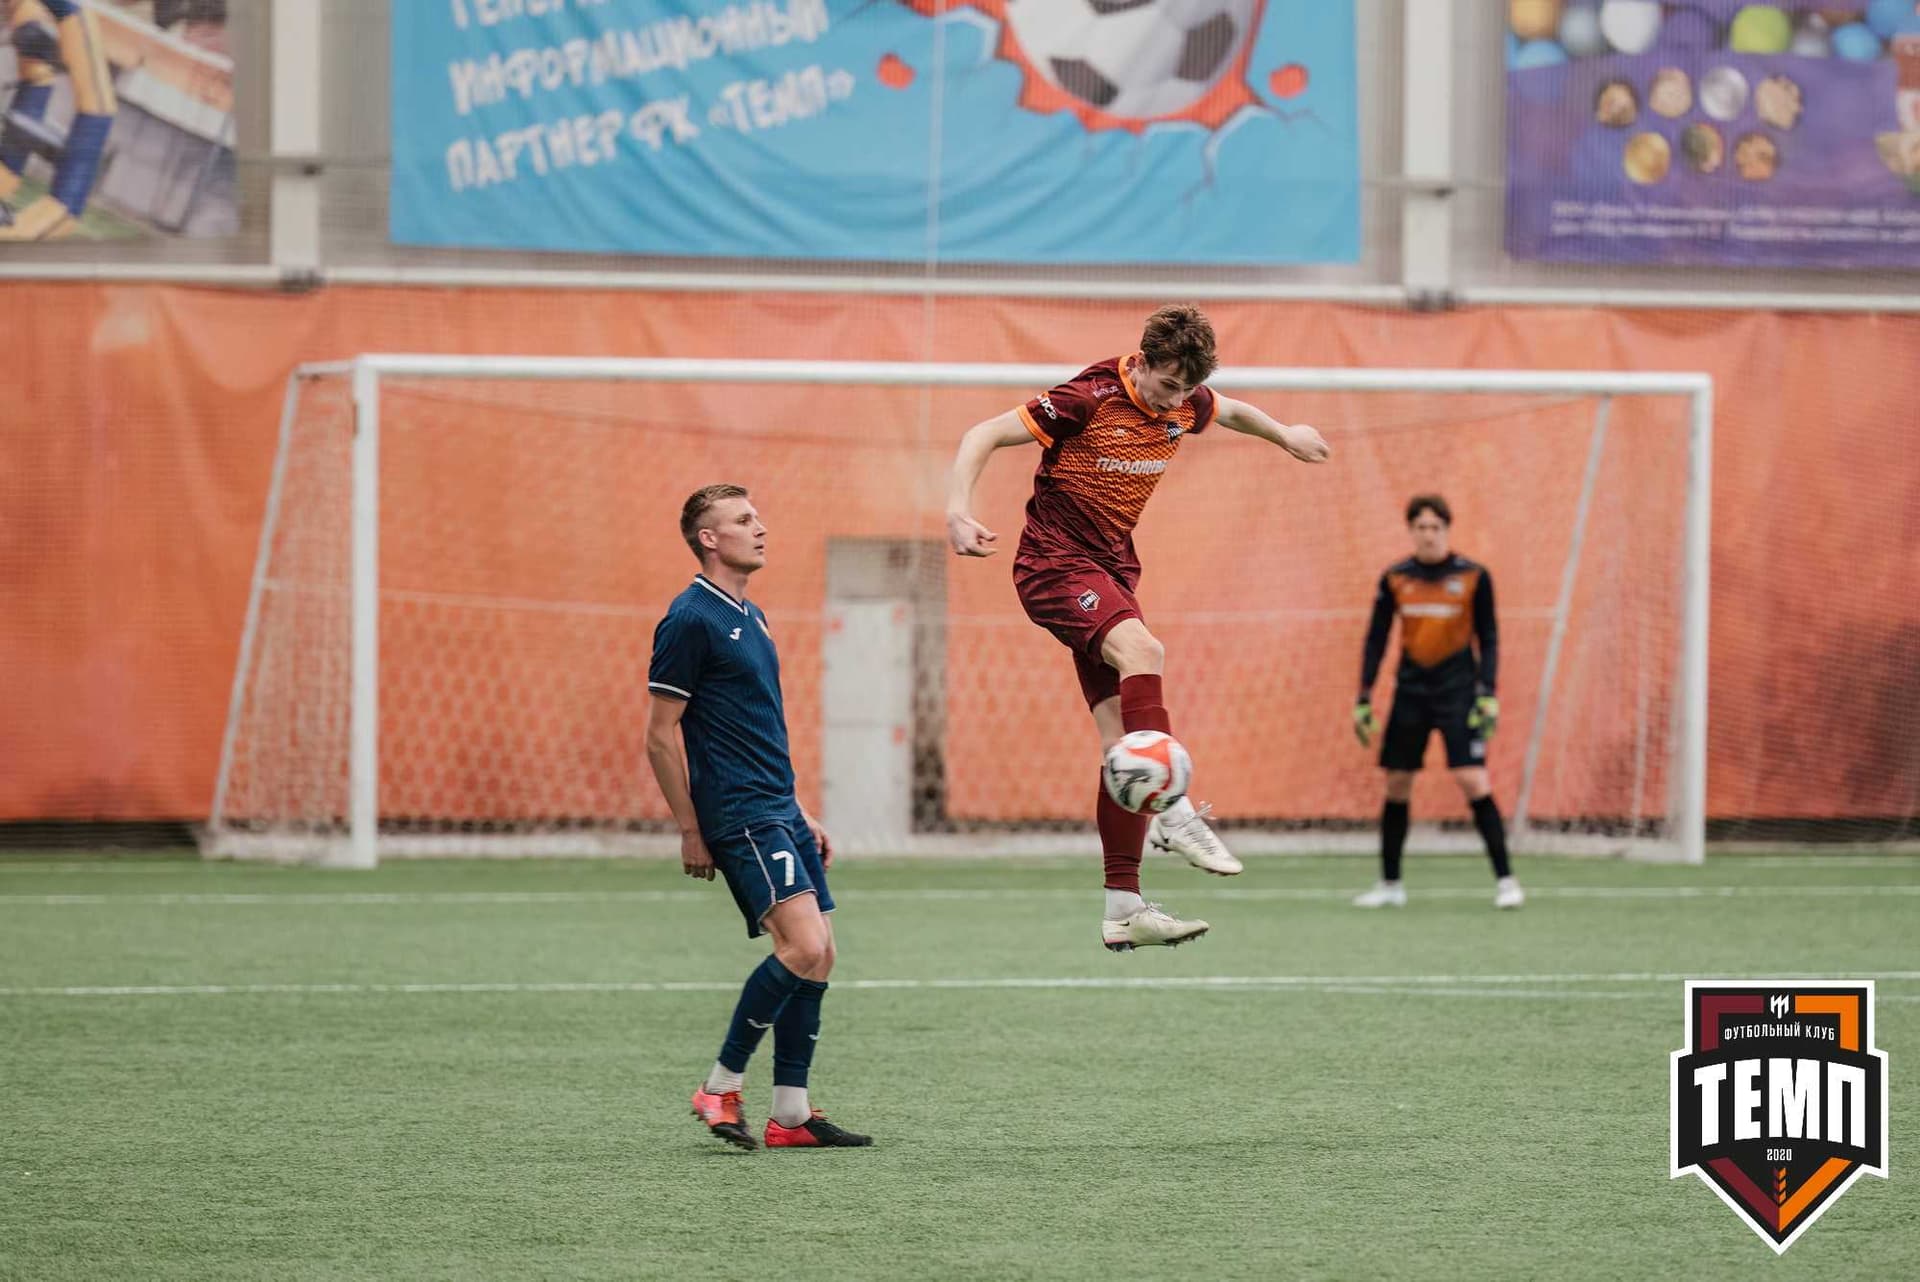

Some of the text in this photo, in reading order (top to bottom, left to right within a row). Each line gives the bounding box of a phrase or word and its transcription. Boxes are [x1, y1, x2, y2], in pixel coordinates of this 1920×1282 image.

[446, 109, 625, 192] ПАРТНЕР
[629, 97, 701, 151] ФК
[771, 850, 796, 887] 7
